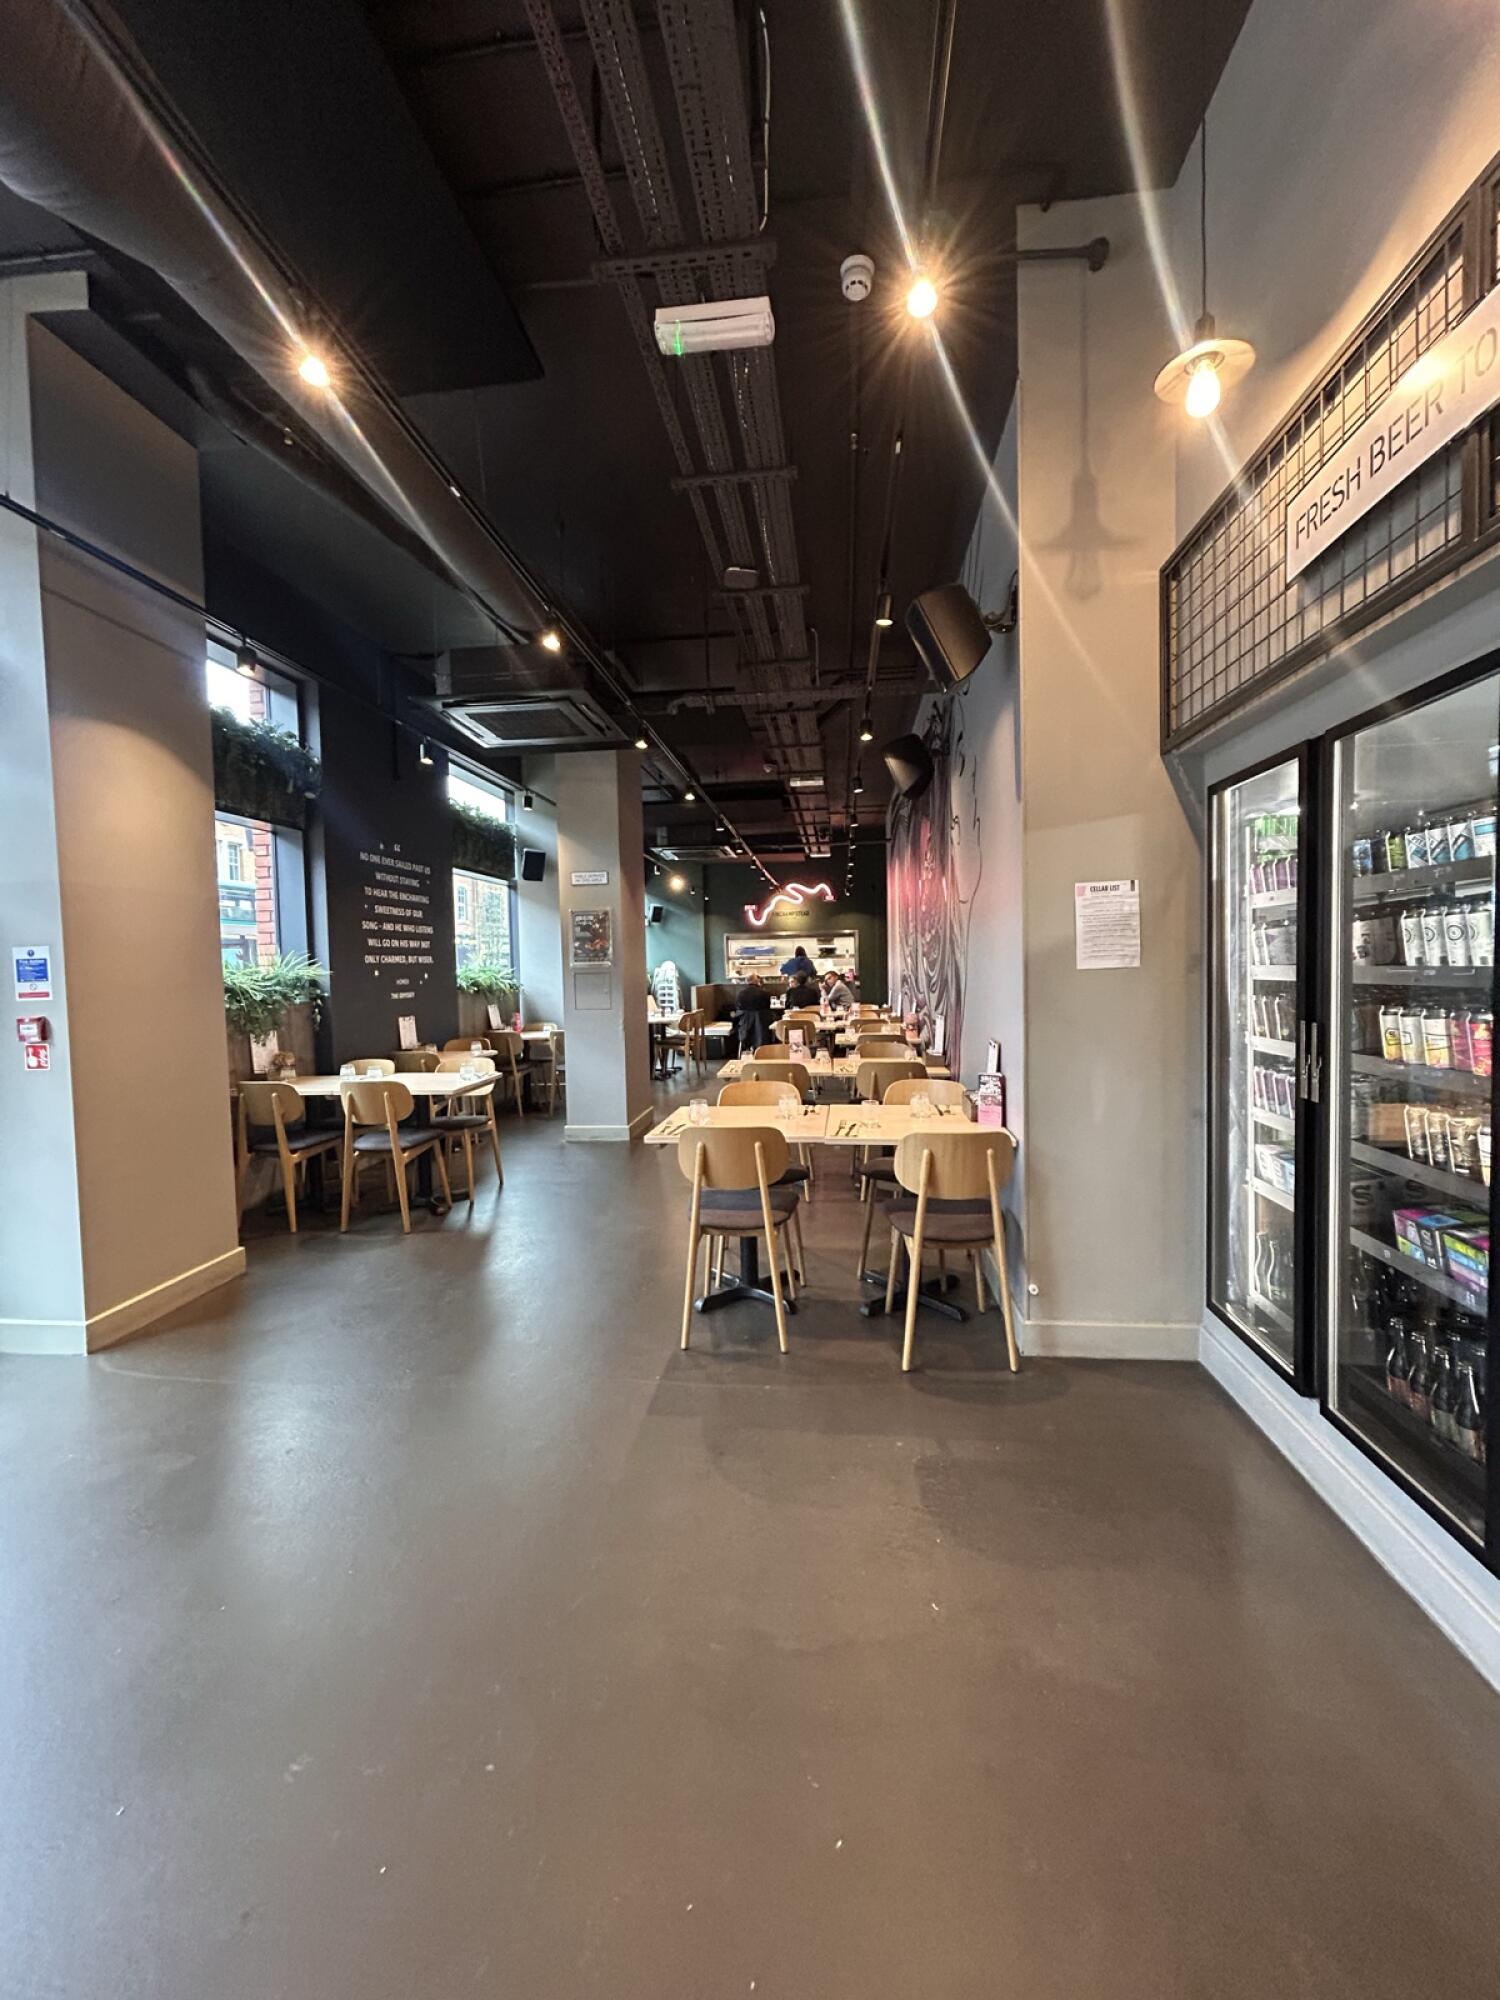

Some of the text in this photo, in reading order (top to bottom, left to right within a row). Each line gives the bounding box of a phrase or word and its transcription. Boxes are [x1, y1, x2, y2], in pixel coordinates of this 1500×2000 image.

[1295, 327, 1498, 550] FRESH BEER TO
[360, 851, 369, 861] NO
[370, 854, 380, 864] ONE
[381, 856, 394, 866] EVER
[375, 872, 399, 883] WITHOUT
[364, 886, 372, 896] TO
[373, 888, 388, 898] HEAR
[388, 890, 398, 900] THE
[374, 905, 424, 918] SWEETNESS OF OUR
[362, 920, 378, 930] SONG
[383, 922, 394, 931] AND
[395, 923, 402, 932] HE
[403, 924, 415, 933] WHO
[368, 938, 431, 949] WILL GO ON HIS WAY NOT
[365, 955, 379, 964] ONLY
[408, 955, 417, 964] BUT
